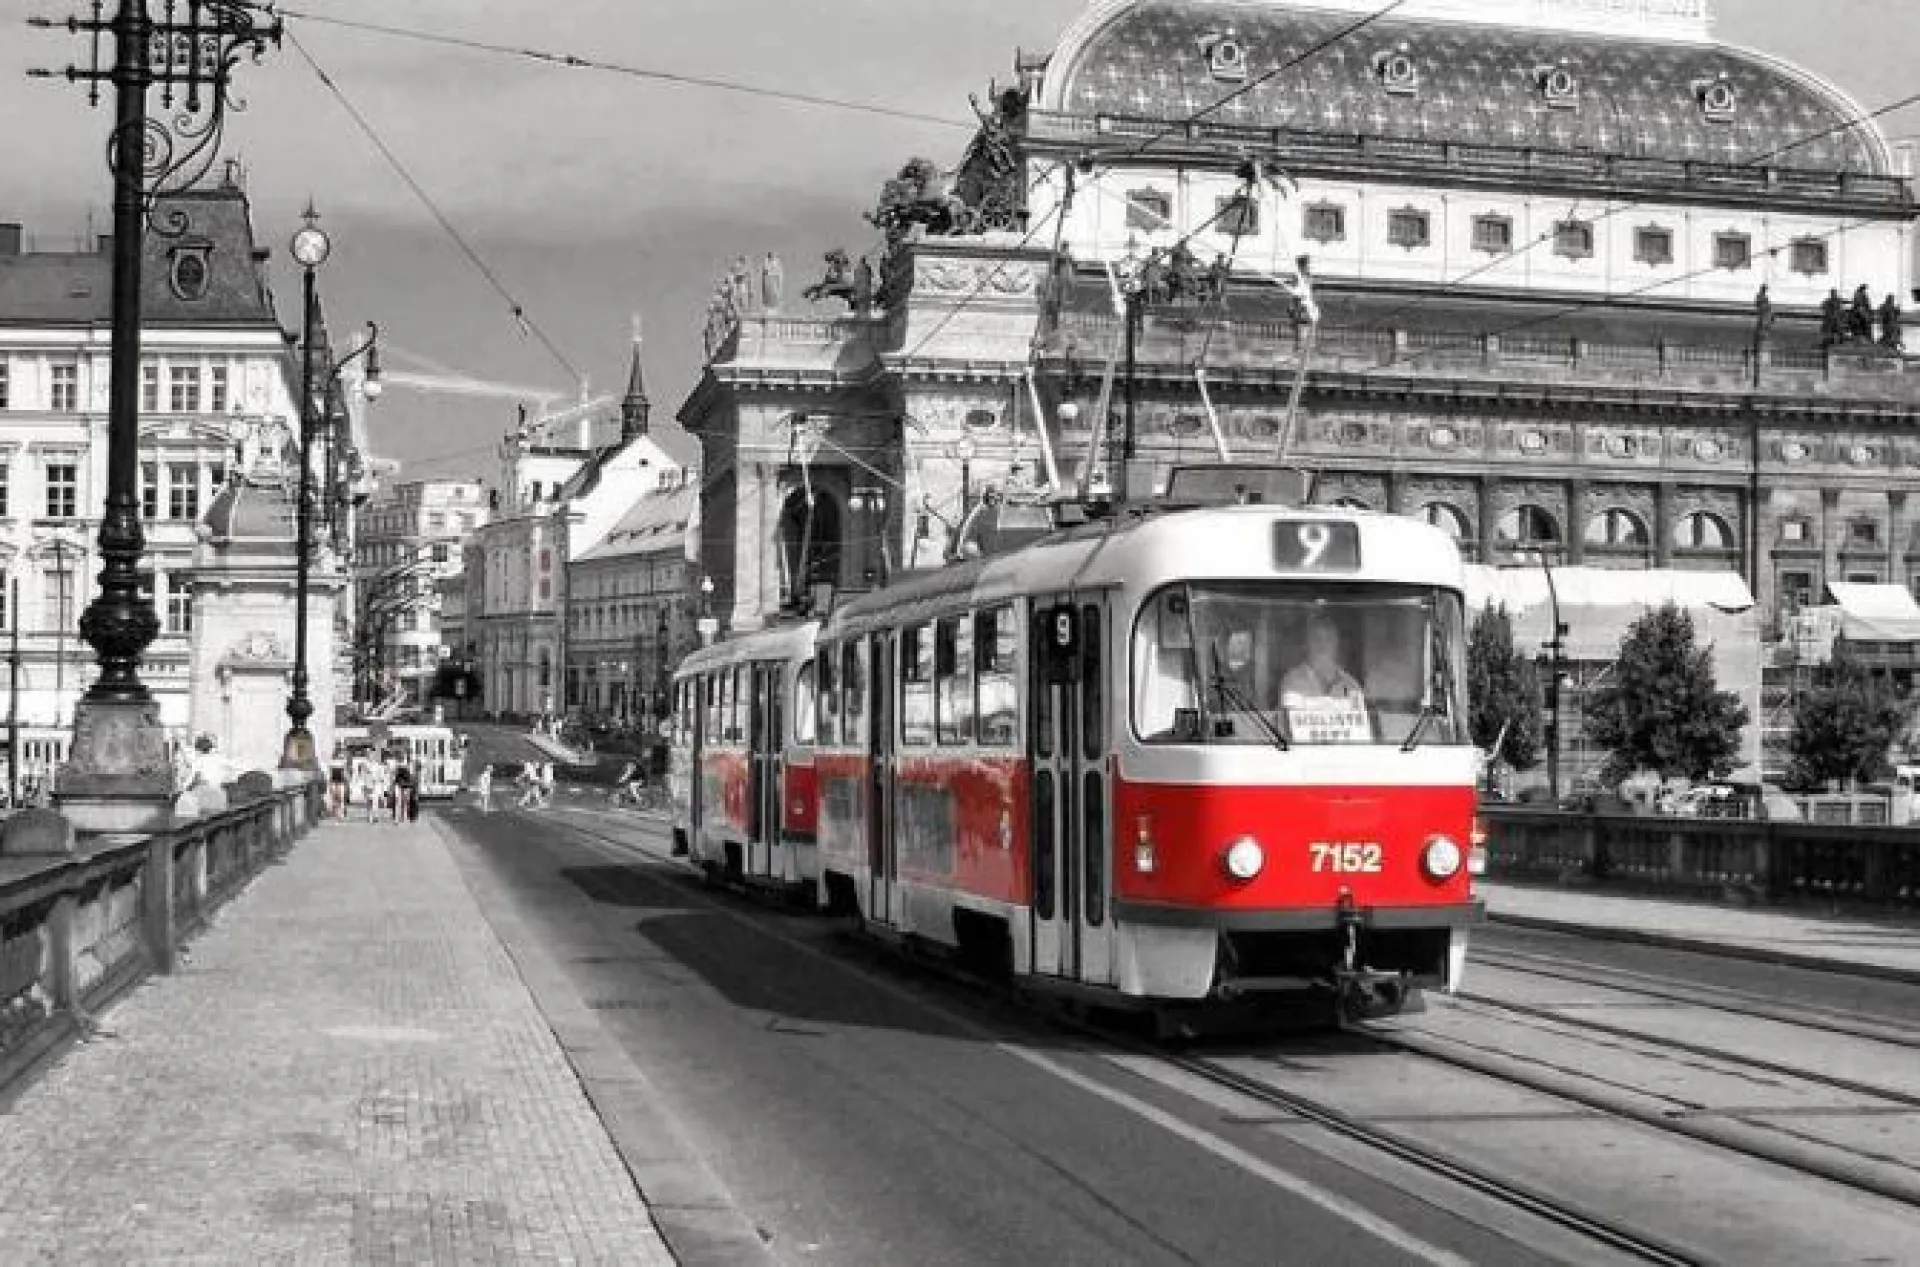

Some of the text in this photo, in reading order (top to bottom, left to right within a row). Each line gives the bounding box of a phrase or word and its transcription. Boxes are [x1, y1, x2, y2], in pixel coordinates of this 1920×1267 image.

[1297, 523, 1330, 566] 9
[1056, 612, 1071, 646] 9
[1309, 842, 1382, 872] 7152
